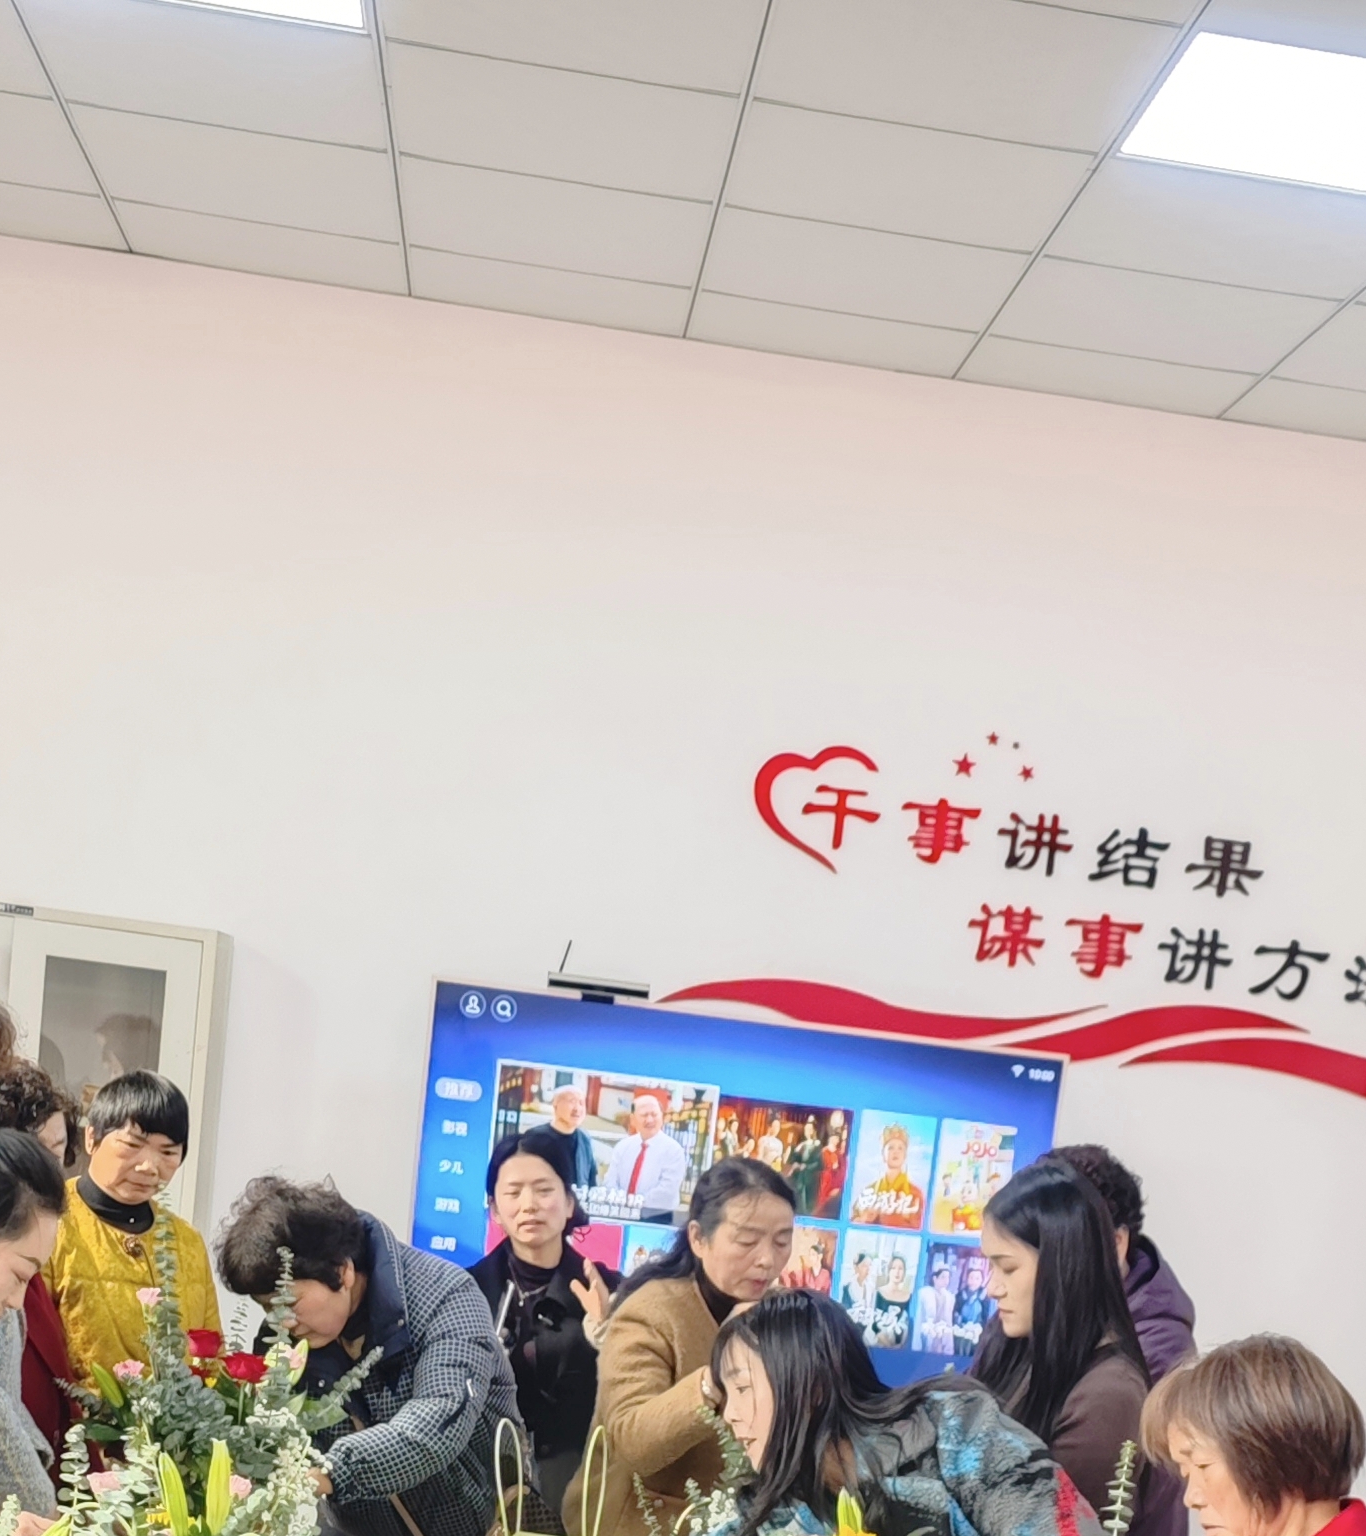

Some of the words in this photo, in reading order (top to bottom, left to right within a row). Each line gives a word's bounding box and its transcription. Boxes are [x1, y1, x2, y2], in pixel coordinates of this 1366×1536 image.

[802, 784, 1264, 897] 干事讲结果
